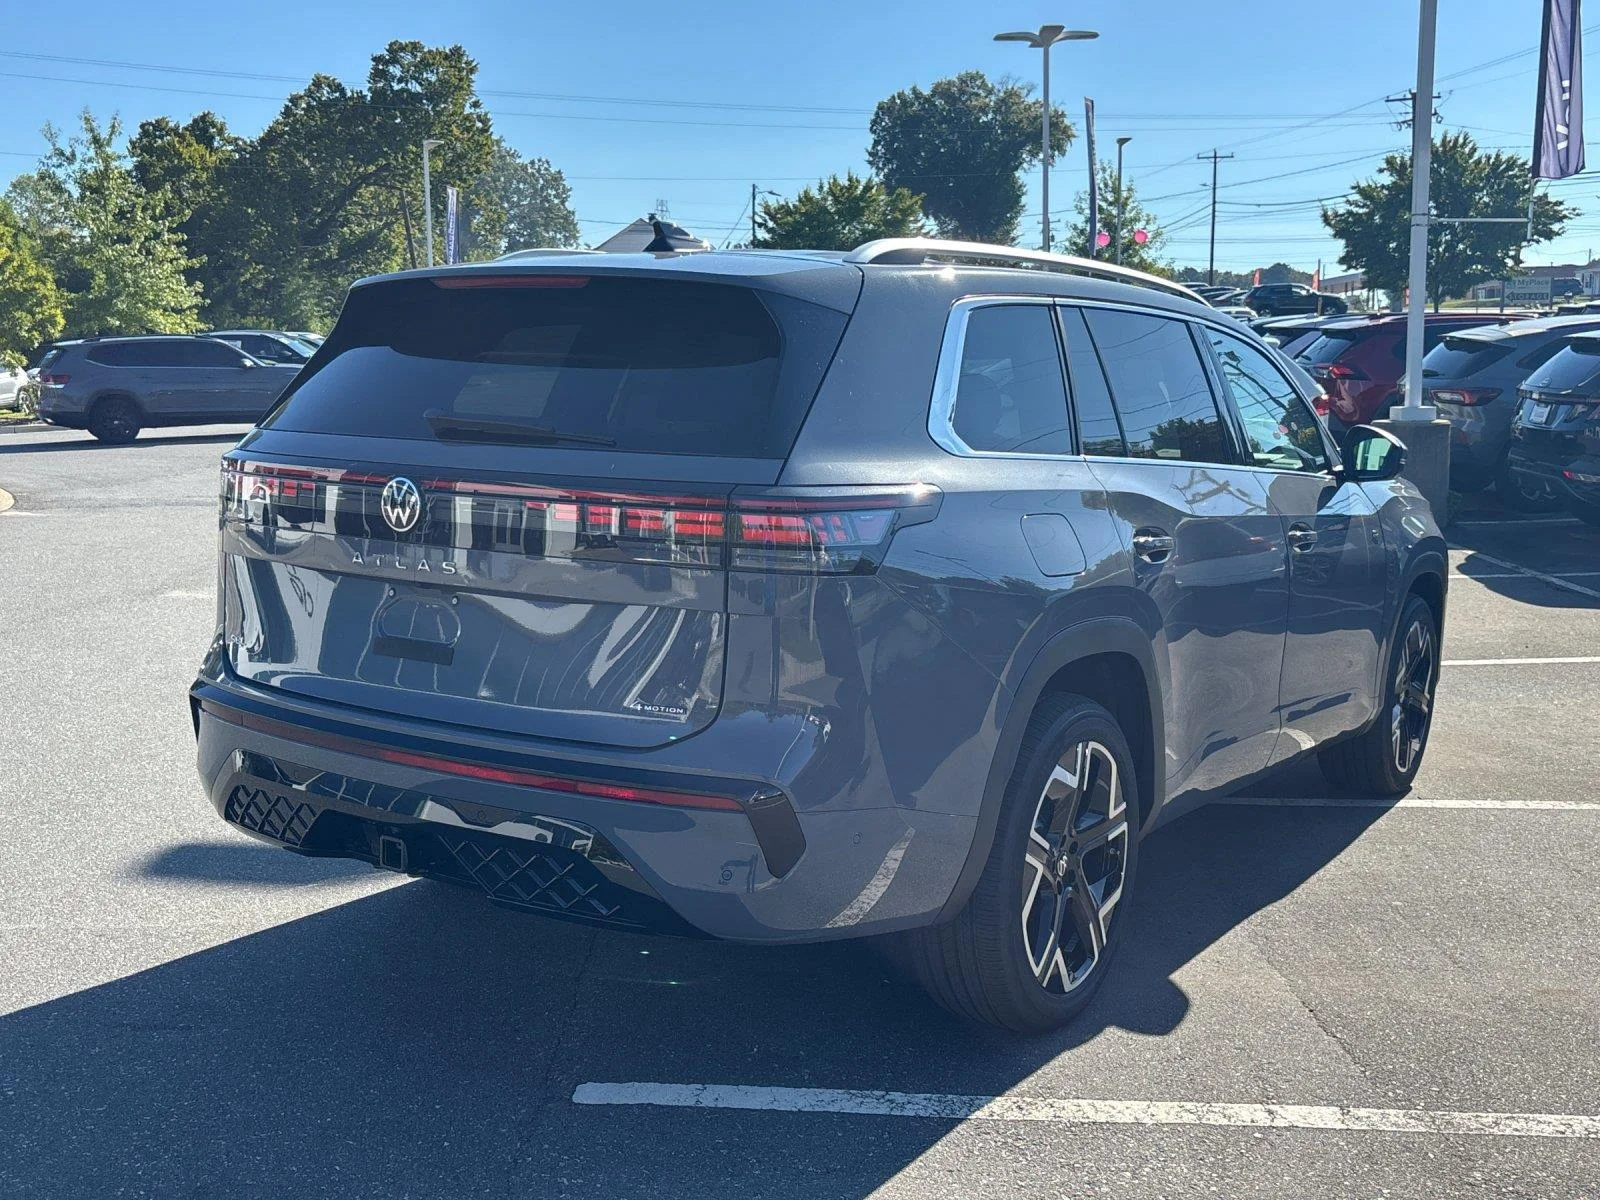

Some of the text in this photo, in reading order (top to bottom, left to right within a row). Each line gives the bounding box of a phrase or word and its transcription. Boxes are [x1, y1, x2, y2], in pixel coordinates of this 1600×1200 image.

[1508, 292, 1548, 300] STORAGE
[382, 478, 419, 531] VW
[351, 551, 456, 575] ATLAS
